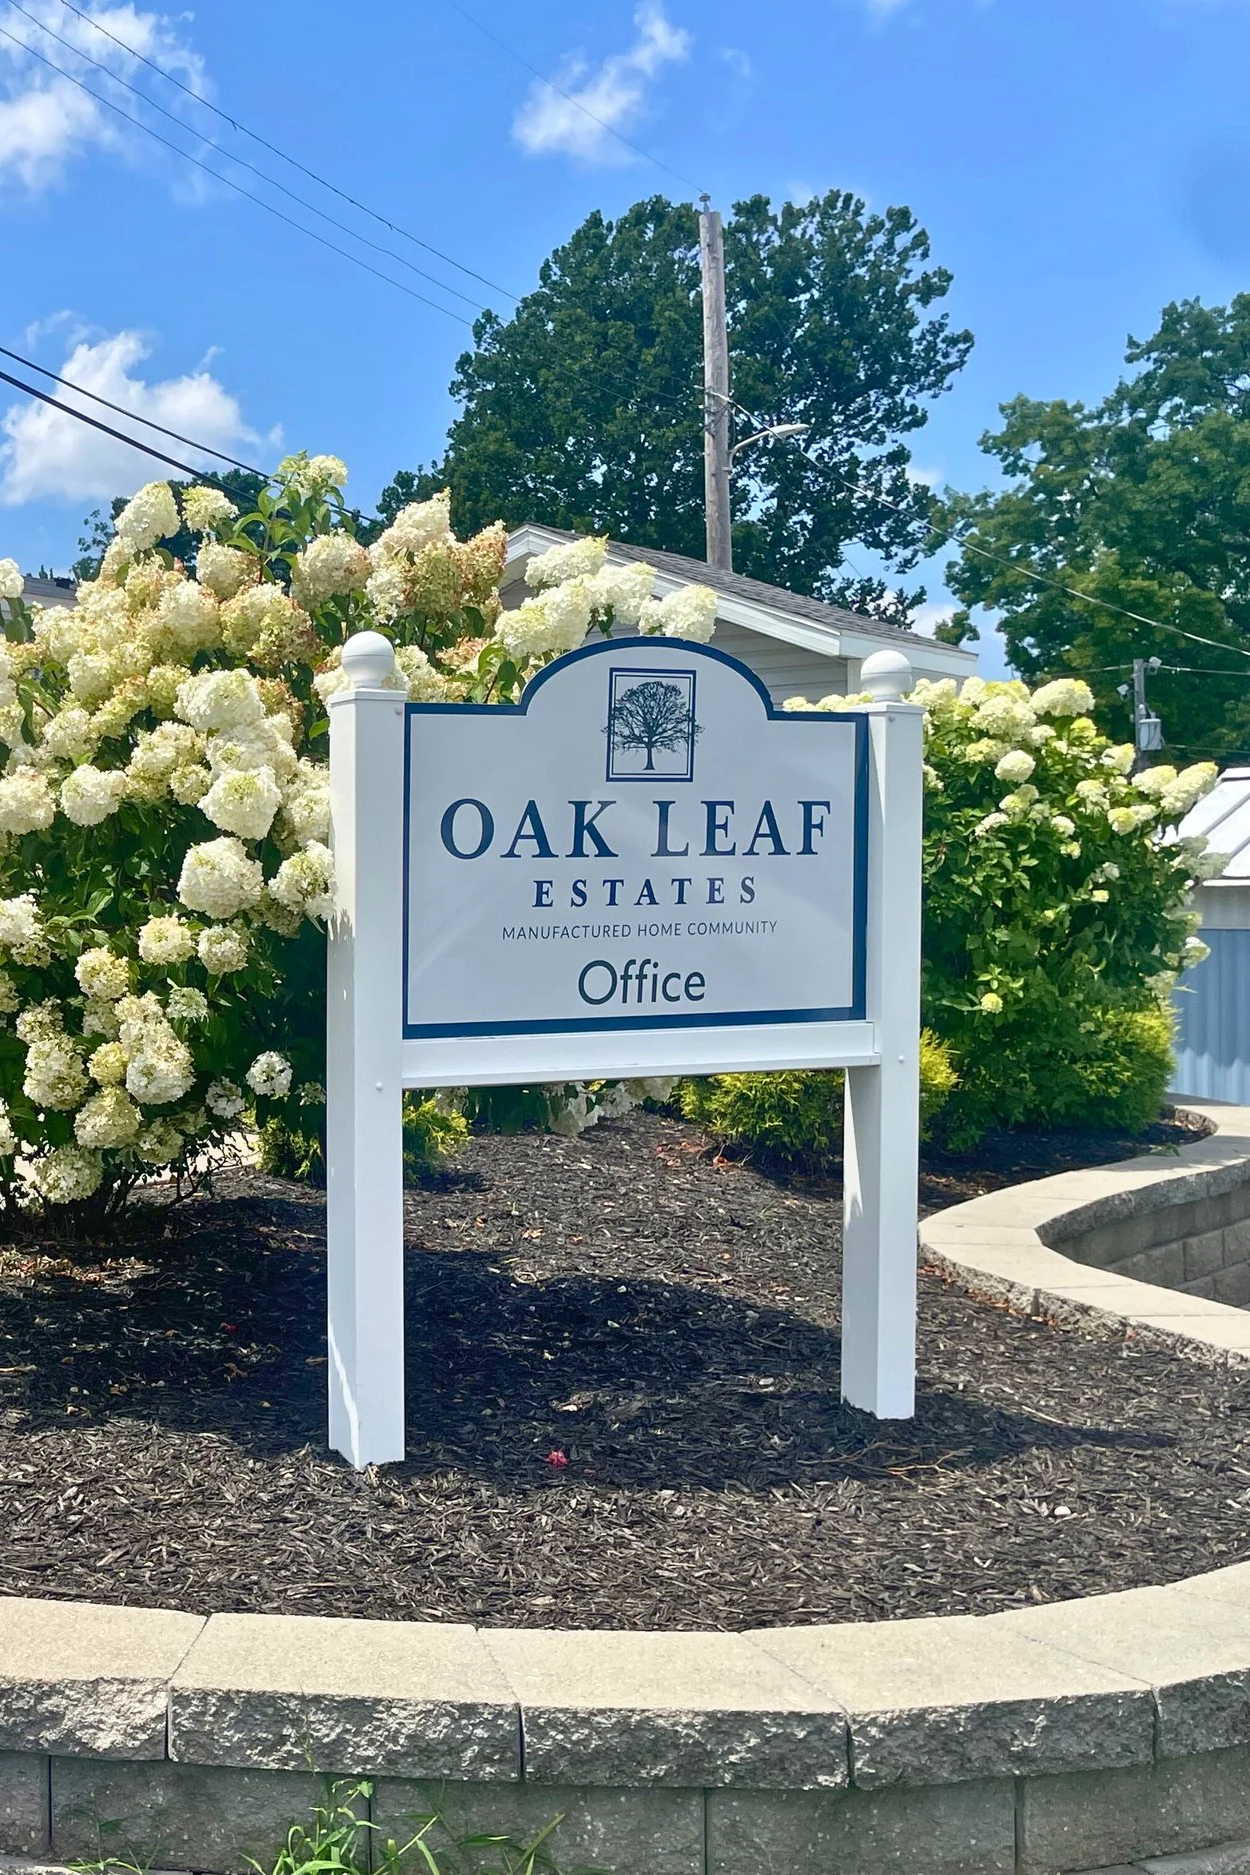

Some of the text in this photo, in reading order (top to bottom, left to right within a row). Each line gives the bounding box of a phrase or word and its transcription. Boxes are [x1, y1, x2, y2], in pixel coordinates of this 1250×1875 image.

[440, 798, 831, 860] OAK LEAF
[531, 876, 755, 908] ESTATES
[502, 920, 778, 940] MANUFACTURED HOME COMMUNITY
[578, 958, 706, 1005] Office
